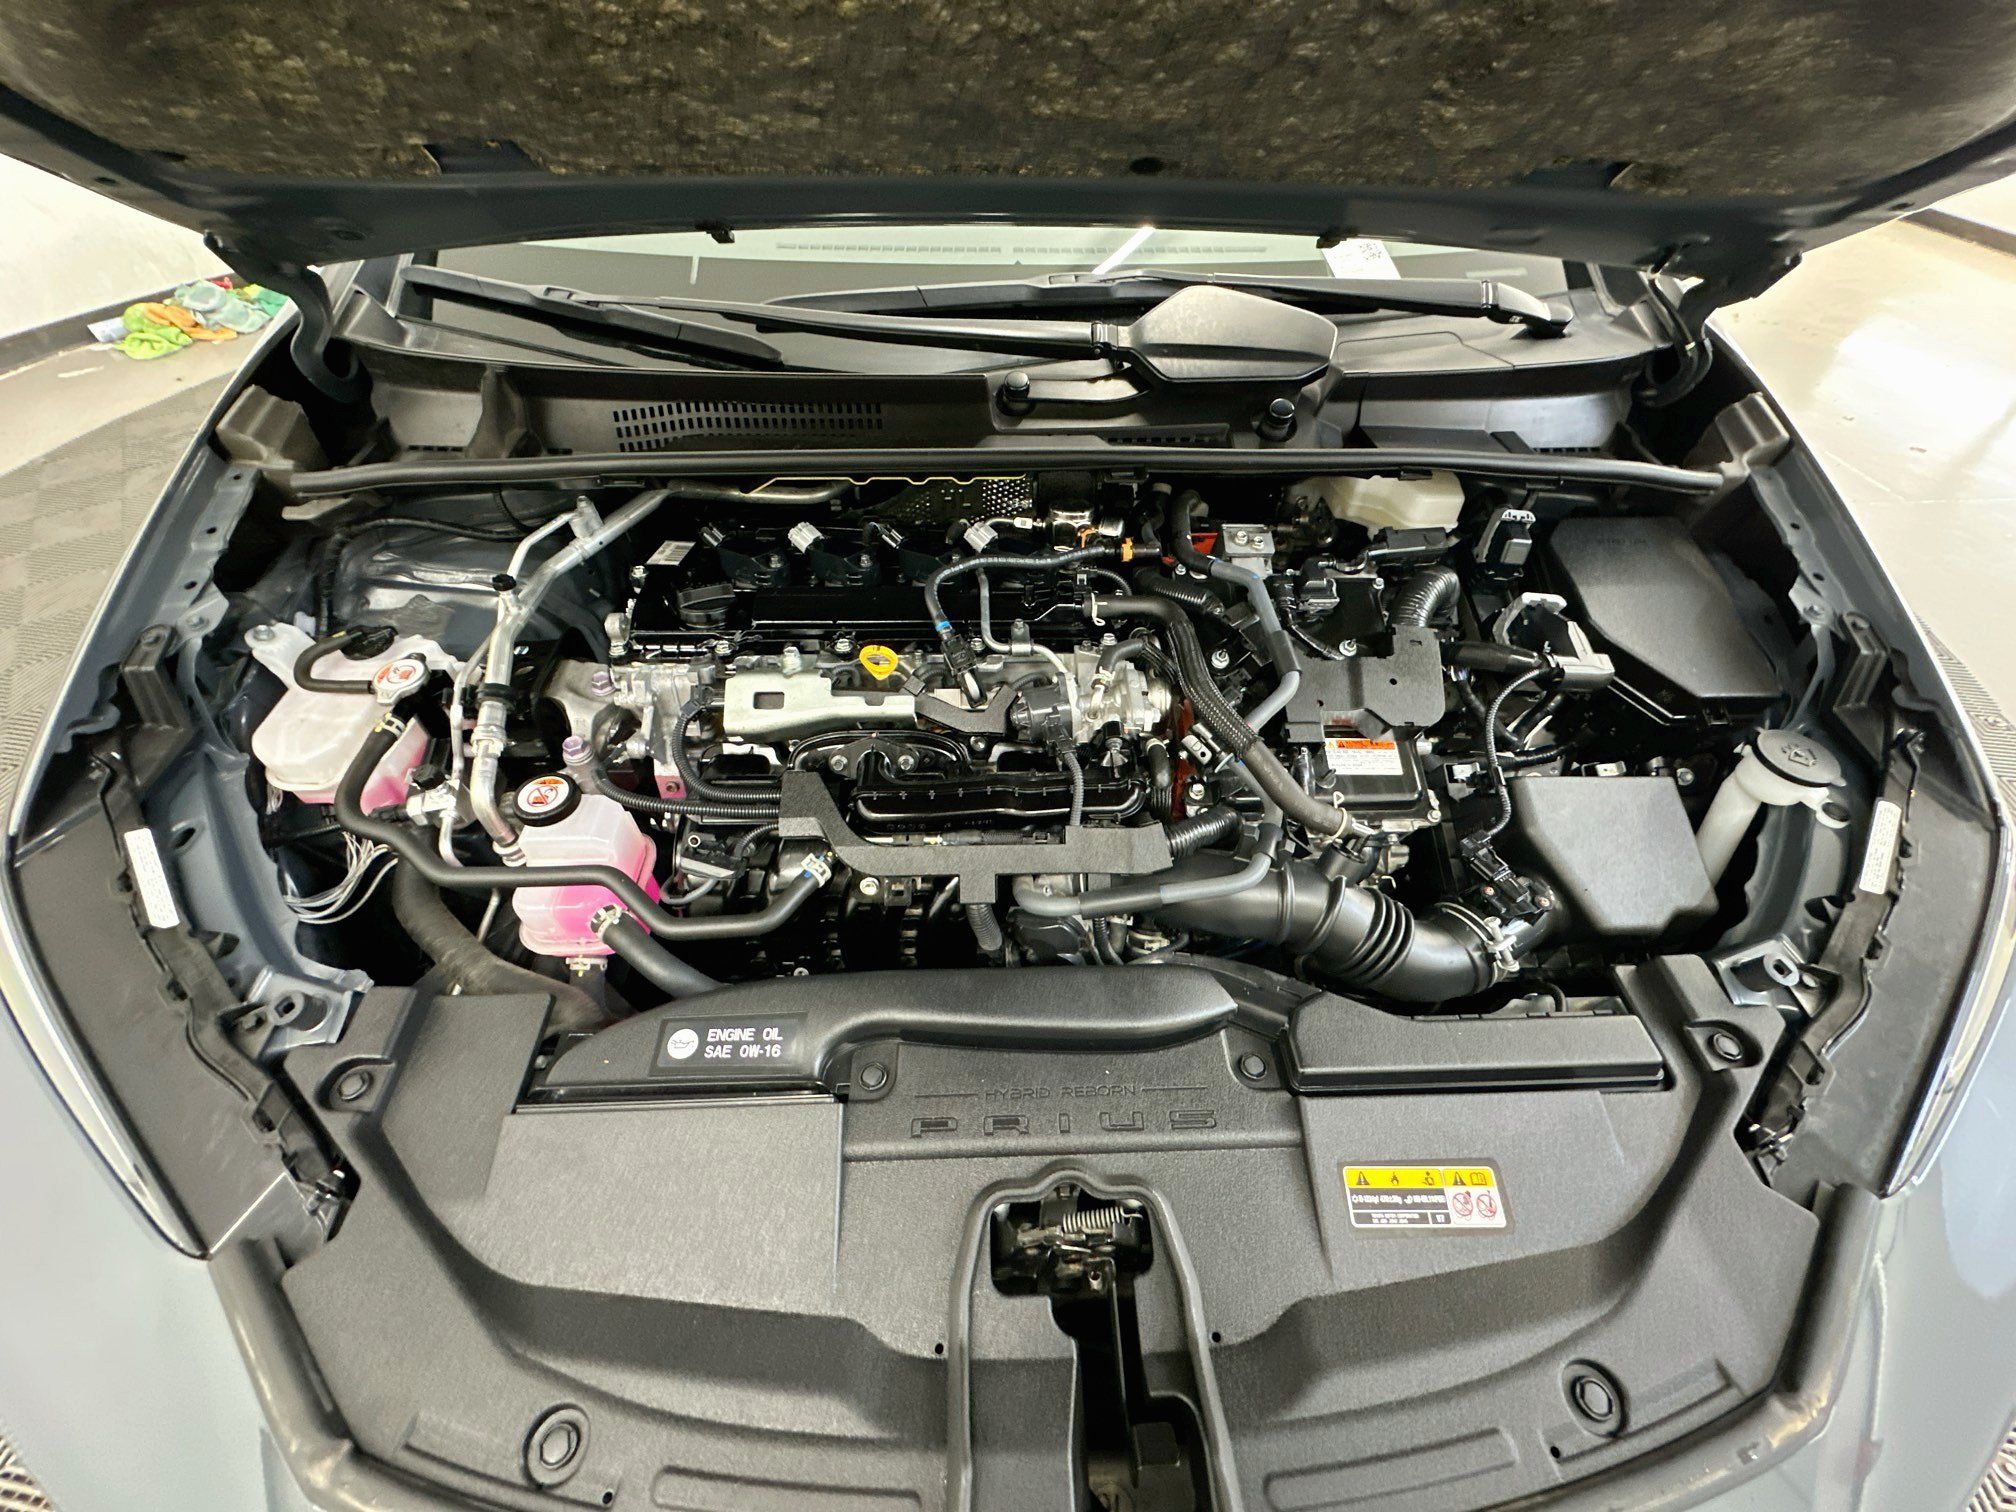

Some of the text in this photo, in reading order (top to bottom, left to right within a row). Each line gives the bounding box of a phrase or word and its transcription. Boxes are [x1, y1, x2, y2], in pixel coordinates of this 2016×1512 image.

[706, 1028, 783, 1042] ENGINE OIL
[704, 1044, 781, 1058] SAE 0W-16
[985, 1085, 1135, 1099] HYBRID REBORN
[911, 1109, 1217, 1138] PRIUS
